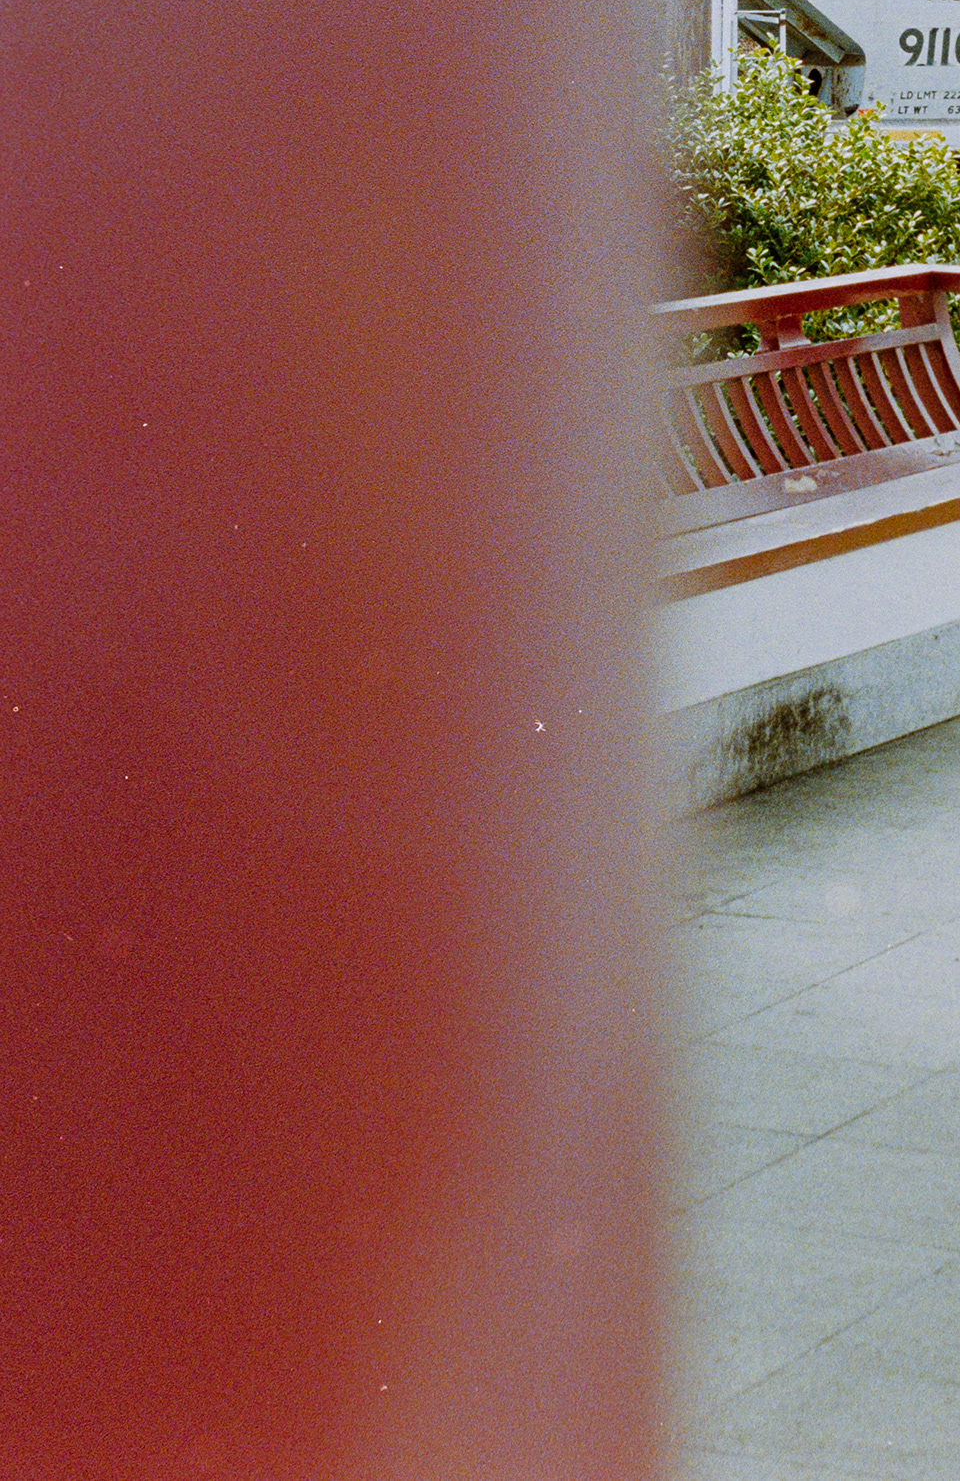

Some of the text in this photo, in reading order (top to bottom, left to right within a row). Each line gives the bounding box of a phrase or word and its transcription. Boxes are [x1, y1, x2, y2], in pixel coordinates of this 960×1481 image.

[900, 91, 913, 100] LD
[916, 90, 938, 100] LMT
[898, 105, 908, 114] LT
[913, 105, 928, 114] WT
